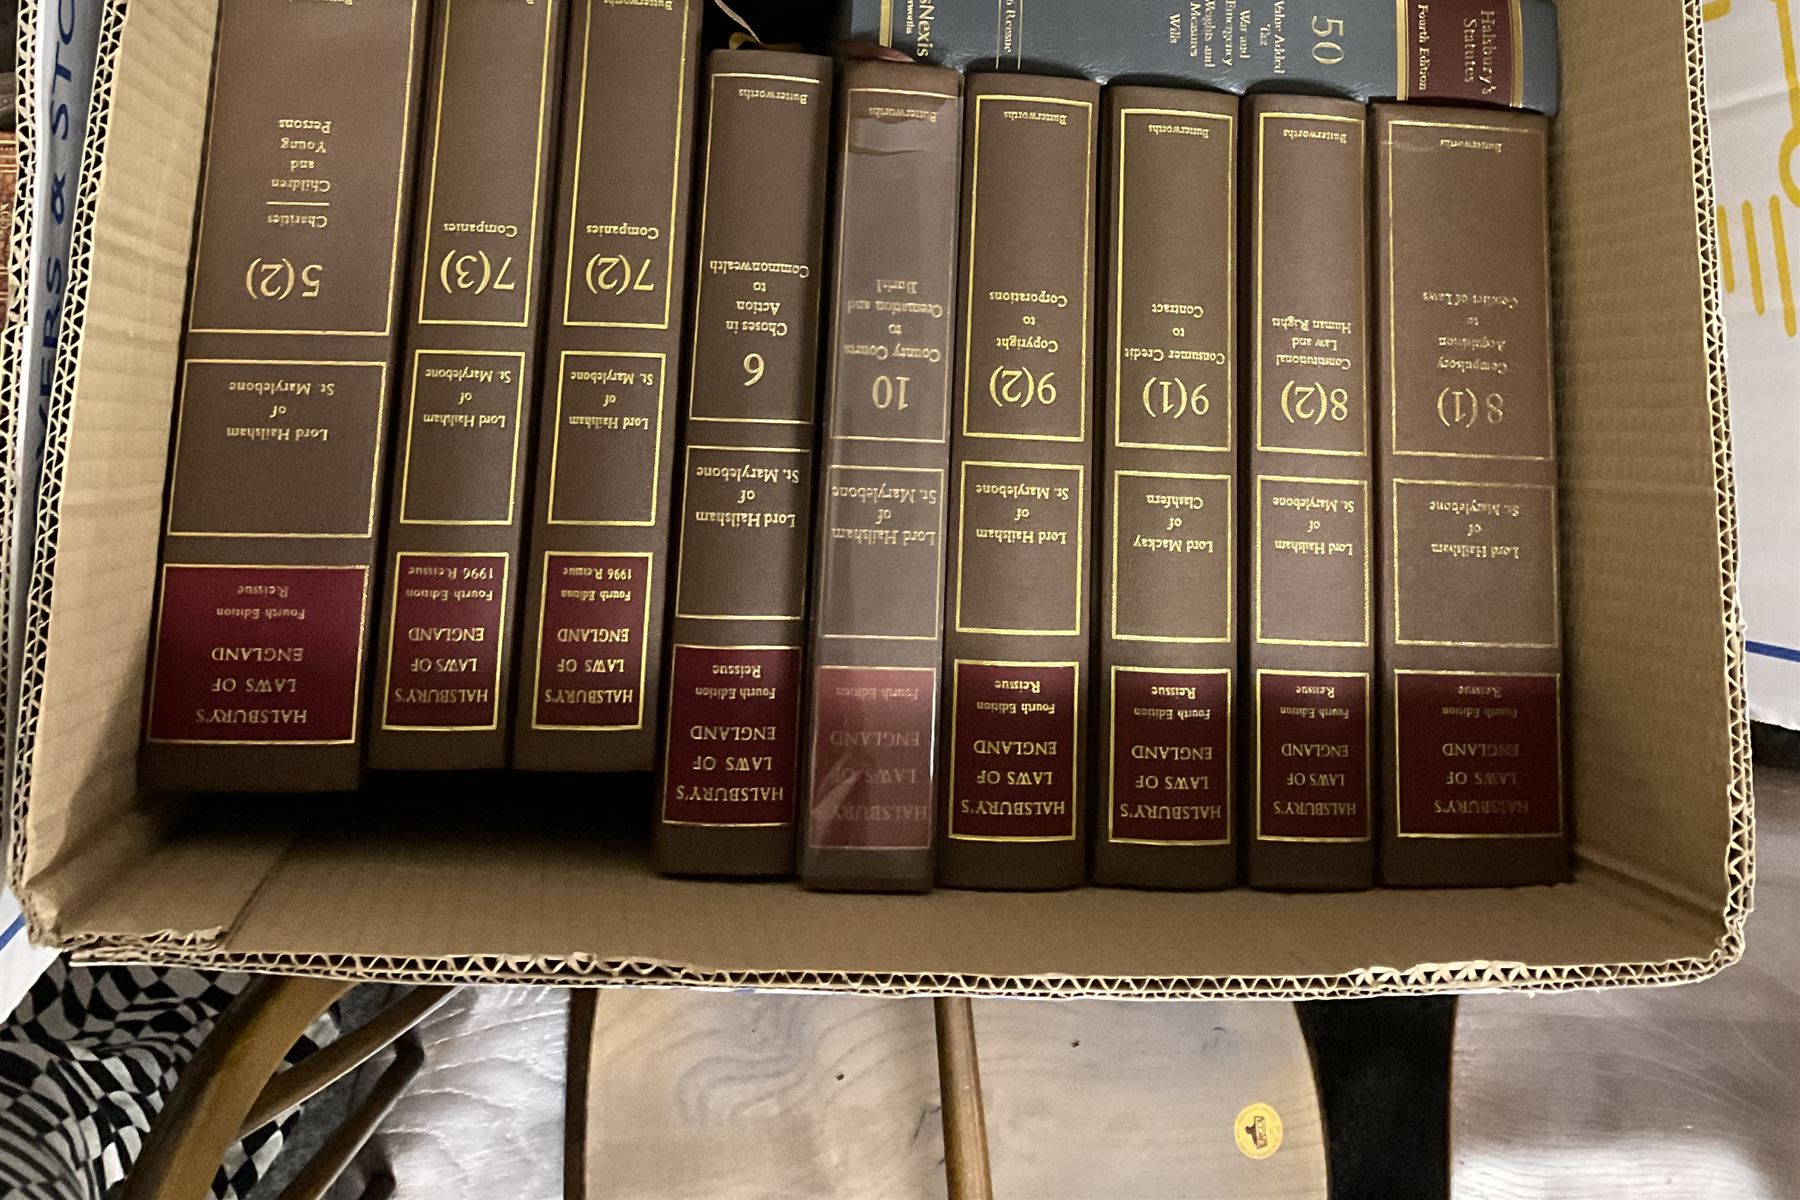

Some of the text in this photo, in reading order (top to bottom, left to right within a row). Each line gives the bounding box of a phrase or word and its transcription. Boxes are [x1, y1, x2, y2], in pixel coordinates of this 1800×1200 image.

[1004, 10, 1016, 52] Reissue
[1169, 14, 1180, 44] Wills
[1191, 2, 1201, 58] Measures
[1222, 0, 1236, 67] Emergency
[1273, 0, 1285, 75] Value Added
[1311, 15, 1344, 65] 50
[1418, 5, 1430, 91] Fourth Edition
[1464, 19, 1474, 84] Statutes
[1481, 10, 1497, 96] Halsbury's
[279, 119, 331, 133] Persons
[281, 137, 326, 154] Young
[290, 160, 314, 170] and
[271, 178, 330, 192] Children
[51, 172, 66, 225] &
[444, 222, 518, 237] Companies
[586, 224, 659, 240] Companies
[440, 250, 516, 295] 7(3)
[585, 252, 655, 295] 7(2)
[989, 291, 1067, 306] Corporations
[736, 301, 780, 315] Action
[1152, 303, 1204, 318] Contract
[726, 320, 787, 336] Choses in
[996, 338, 1059, 352] Copyright
[1125, 348, 1225, 365] Consumer Credit
[743, 353, 765, 386] 6
[1438, 357, 1507, 375] Compulsory
[872, 375, 910, 410] 10
[989, 366, 1057, 407] 9(2)
[459, 392, 472, 404] of
[1143, 378, 1209, 418] 9(1)
[1280, 380, 1348, 424] 8(2)
[269, 405, 287, 418] of
[696, 466, 800, 483] St. Marylebone
[738, 490, 755, 503] of
[1147, 494, 1203, 508] Clashfern
[696, 512, 796, 527] Lord Hailsham
[1015, 508, 1029, 520] of
[1167, 517, 1182, 530] of
[976, 529, 1066, 544] Lord Hailsham
[1134, 537, 1213, 553] Lord Mackay
[408, 628, 484, 641] ENGLAND
[212, 647, 303, 661] ENGLAND
[411, 658, 478, 671] LAWS OF
[713, 665, 761, 677] Reissue
[212, 678, 296, 691] LAWS OF
[995, 680, 1041, 693] Reissue
[696, 687, 775, 698] Fourth Edition
[1151, 686, 1196, 699] Reissue
[976, 702, 1055, 714] Fourth Edition
[690, 726, 775, 741] ENGLAND
[974, 741, 1057, 755] ENGLAND
[1132, 745, 1213, 759] ENGLAND
[693, 756, 772, 770] LAWS OF
[976, 770, 1053, 784] LAWS OF
[1135, 775, 1208, 789] LAWS OF
[676, 786, 783, 800] HALSBURY'S
[962, 799, 1065, 814] HALSBURY'S
[1120, 804, 1221, 819] HALSBURY'S
